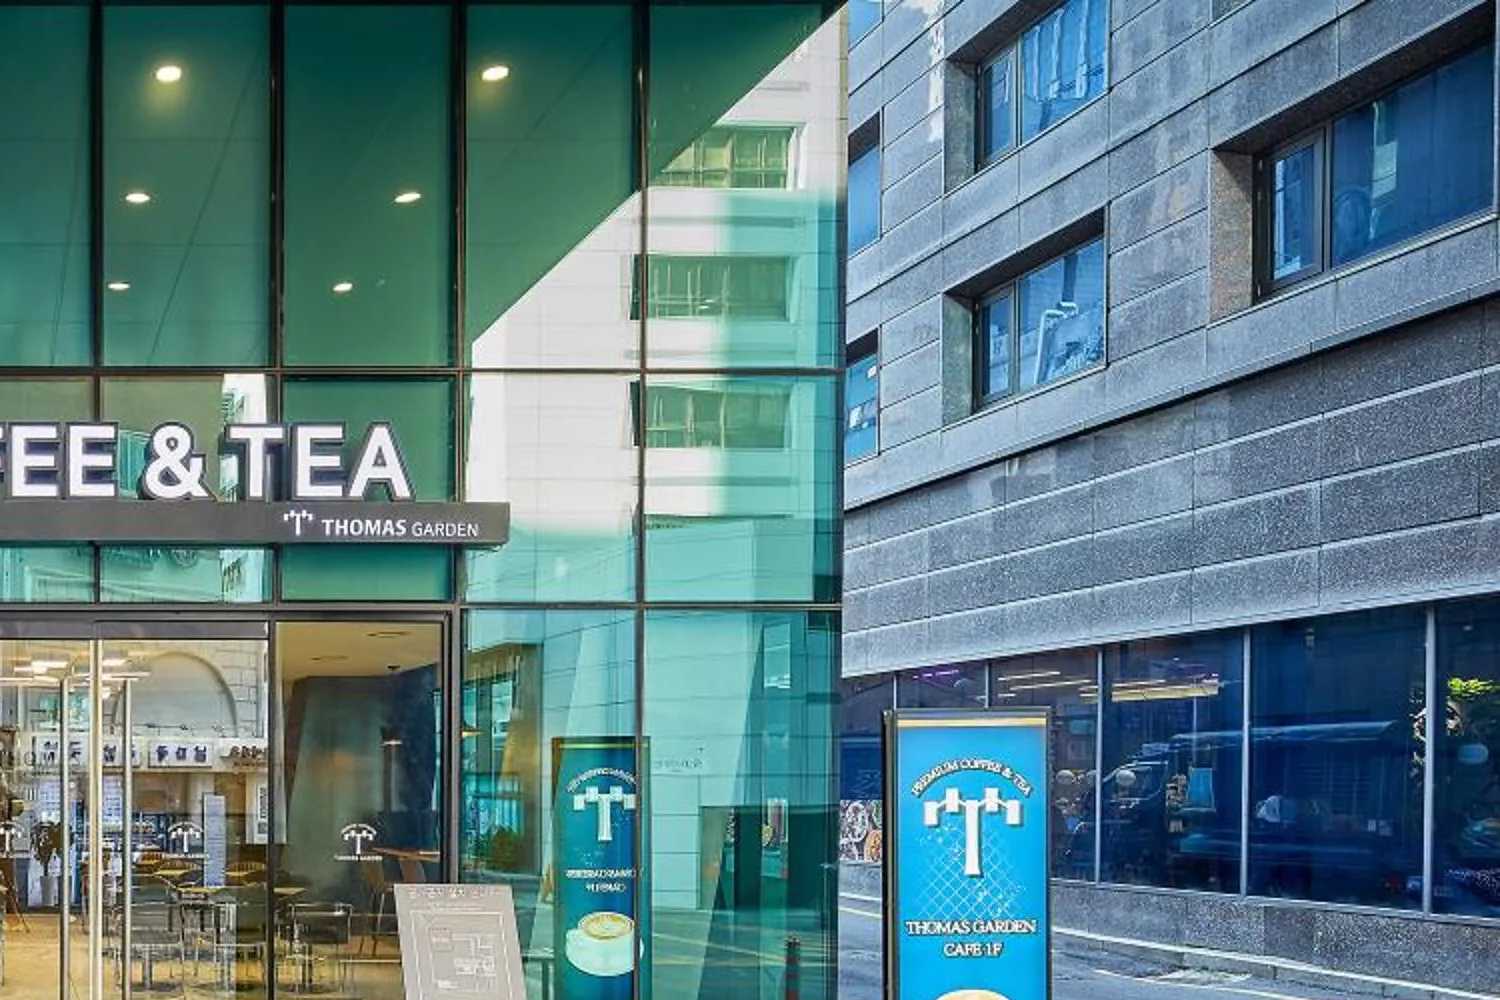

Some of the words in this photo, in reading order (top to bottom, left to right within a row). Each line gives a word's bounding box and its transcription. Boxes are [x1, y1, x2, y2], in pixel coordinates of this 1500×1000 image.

[143, 423, 208, 498] &
[228, 424, 411, 498] TEA
[321, 519, 407, 537] THOMAS
[411, 522, 479, 537] GARDEN
[905, 920, 972, 935] THOMAS
[973, 919, 1038, 934] GARDEN
[943, 943, 982, 958] CAFE
[985, 943, 1004, 957] 1F
